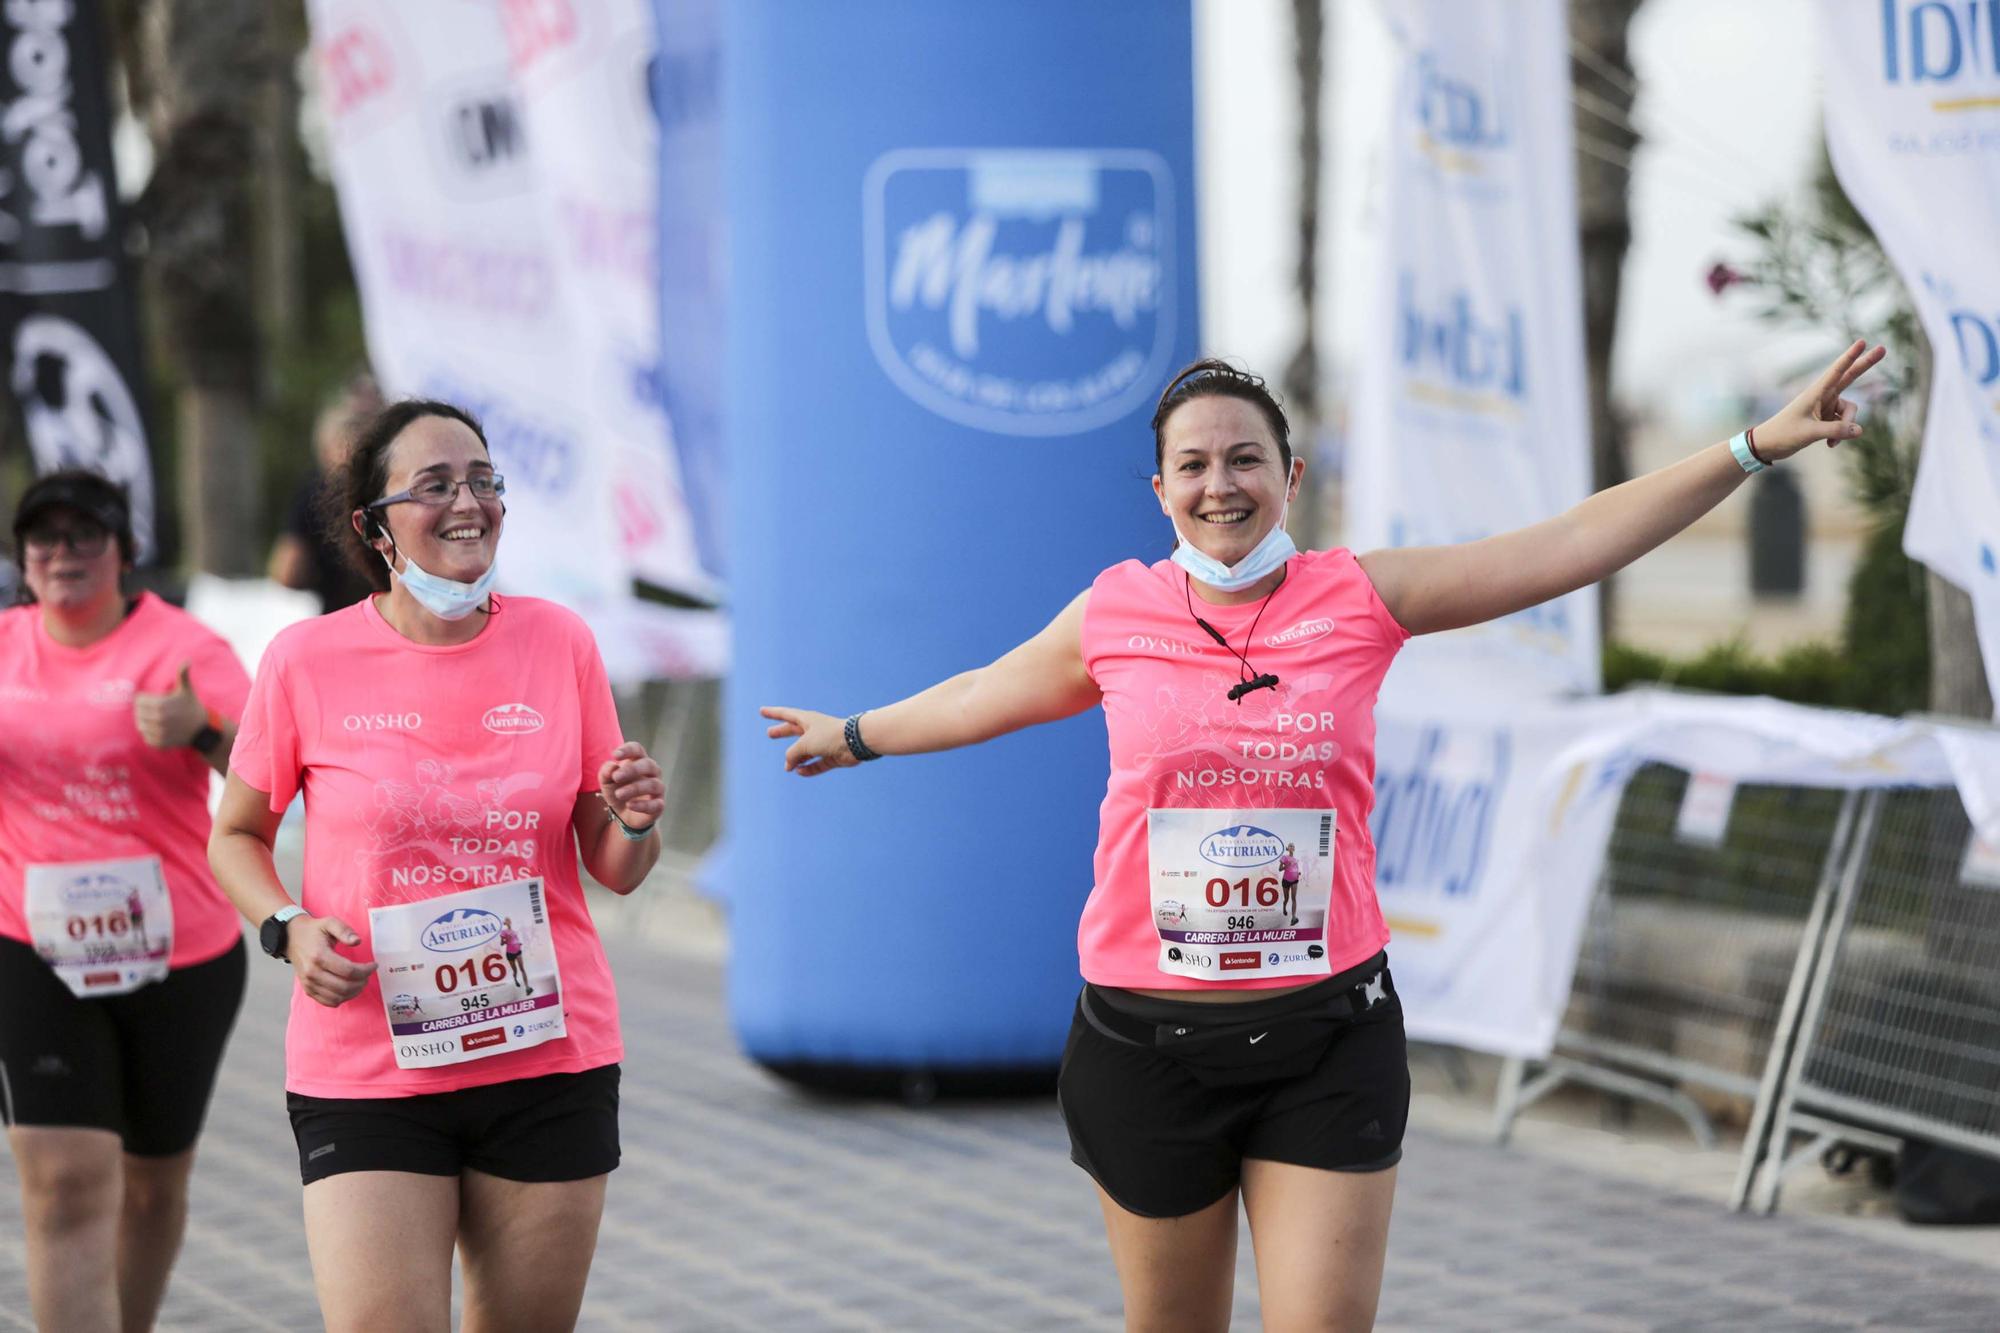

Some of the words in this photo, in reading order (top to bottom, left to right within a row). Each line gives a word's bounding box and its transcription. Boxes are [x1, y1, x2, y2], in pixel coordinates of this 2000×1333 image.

[1271, 623, 1330, 646] ASTURIANA
[344, 712, 422, 731] OYSHO
[1276, 711, 1335, 732] POR
[1238, 741, 1333, 762] TODAS
[1177, 768, 1325, 789] NOSOTRAS
[485, 810, 541, 830] POR
[449, 837, 535, 859] TODAS
[1206, 840, 1278, 857] ASTURIANA
[392, 864, 531, 887] NOSOTRAS
[1205, 877, 1280, 908] 016
[68, 911, 129, 940] 016
[1227, 915, 1255, 930] 946
[428, 922, 497, 947] ASTURIANA
[1184, 932, 1230, 943] CARRERA
[1232, 932, 1246, 942] DE
[1247, 932, 1260, 941] LA
[1262, 930, 1297, 941] MUJER
[1231, 957, 1256, 965] Santander
[435, 953, 507, 994] 016
[461, 993, 490, 1011] 945
[422, 1015, 469, 1032] CARRERA
[470, 1012, 485, 1023] DE
[486, 1008, 500, 1019] LA
[501, 1000, 536, 1016] MUJER
[400, 1041, 455, 1058] OYSHO
